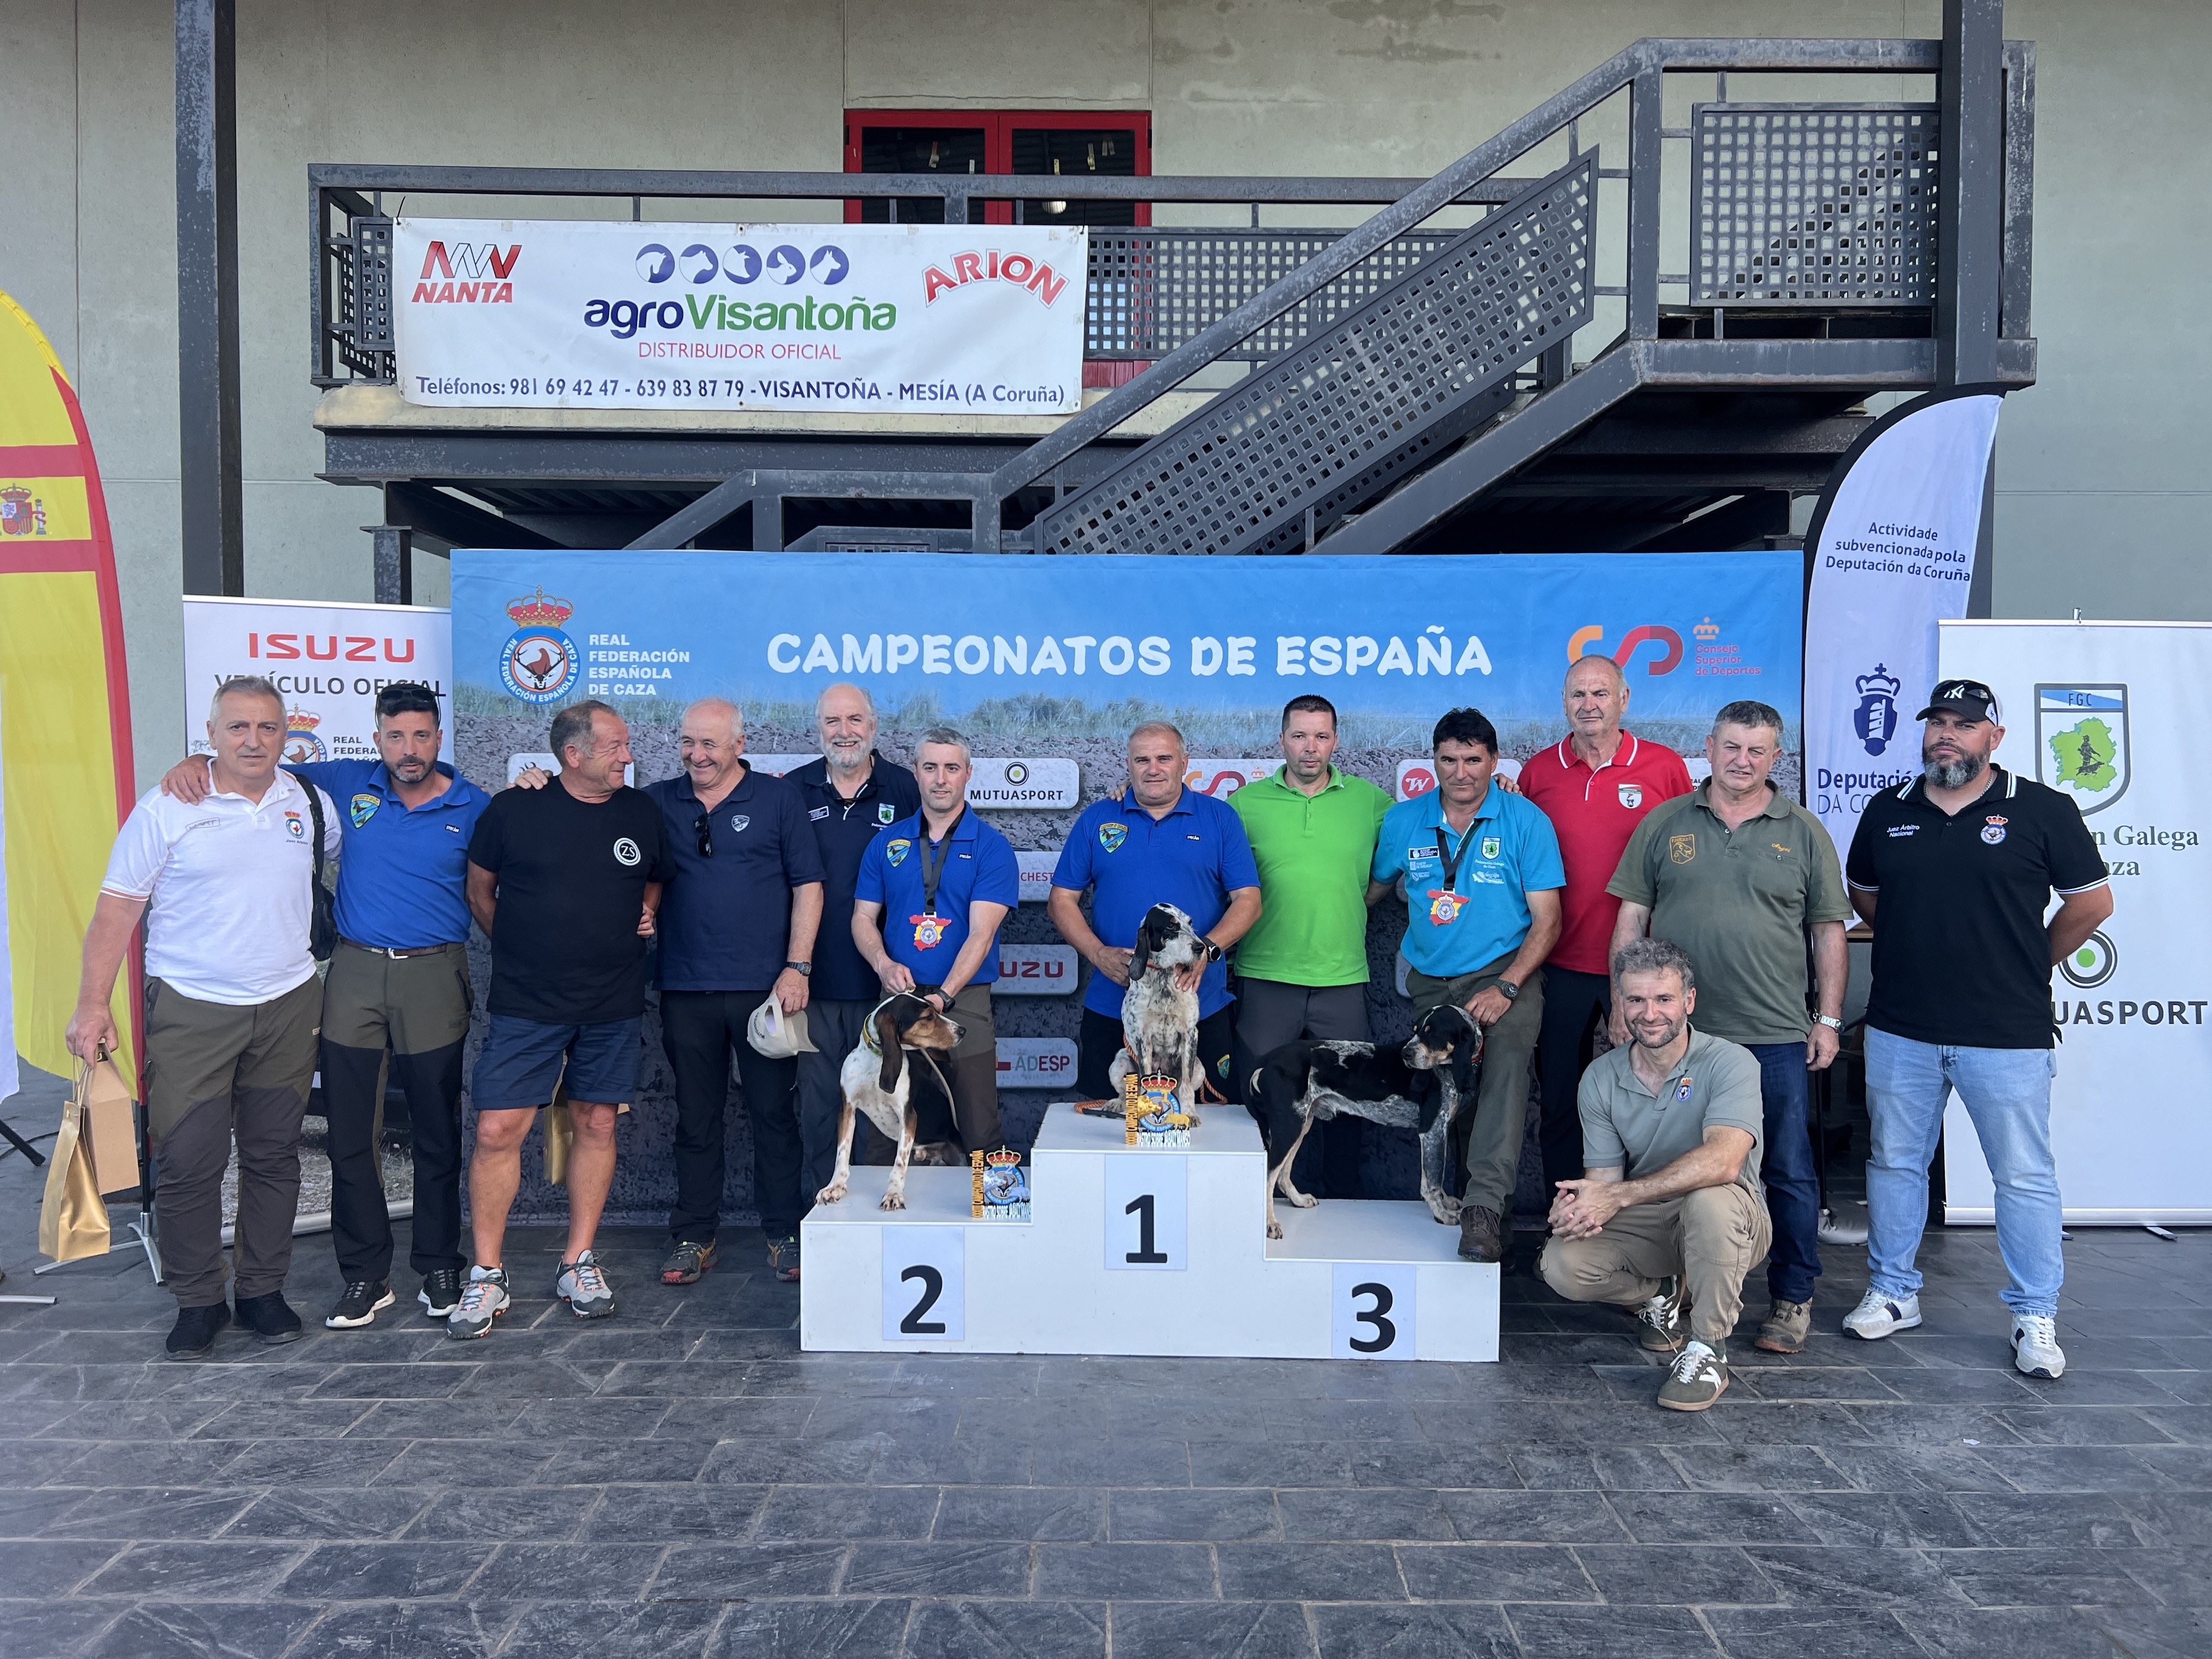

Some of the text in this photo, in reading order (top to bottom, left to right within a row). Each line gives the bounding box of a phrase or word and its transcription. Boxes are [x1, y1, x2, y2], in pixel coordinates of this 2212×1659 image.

[922, 249, 1070, 309] ARION
[411, 282, 513, 303] NANTA
[584, 294, 896, 338] agroVisantoña
[639, 342, 842, 359] DISTRIBUIDOR OFICIAL
[416, 376, 505, 394] Teléfonos:
[510, 378, 538, 395] 981
[545, 379, 566, 395] 69
[572, 379, 592, 396] 42
[599, 379, 619, 396] 47
[636, 379, 665, 397] 639
[673, 380, 692, 397] 83
[698, 380, 717, 397] 87
[725, 380, 743, 397] 79
[759, 377, 879, 399] VISANTOÑA
[900, 380, 959, 401] MESÍA
[965, 383, 986, 405] (A
[992, 385, 1064, 405] Coruña)
[1869, 522, 1938, 541] Actividade
[1835, 539, 1966, 563] subvencionada pola
[1826, 556, 1971, 581] Deputación da Coruña
[249, 633, 415, 663] ISUZU
[589, 634, 629, 645] REAL
[1695, 644, 1739, 654] Consejo
[589, 649, 690, 662] FEDERACIÓN
[768, 625, 1492, 676] CAMPEONATOS DE ESPAÑA
[1695, 654, 1742, 665] Superior
[502, 638, 578, 702] REAL FEDERACIÓN ESPAÑOLA DE CAZA
[589, 664, 672, 679] ESPAÑOLA
[1695, 666, 1761, 676] de Deportes
[214, 671, 345, 695] VÍCULO
[589, 684, 656, 695] DE CAZA
[2068, 693, 2092, 706] FGC
[314, 738, 325, 753] CAZA
[1818, 769, 1917, 794] Deputació
[970, 790, 1063, 801] MUTUASPORT
[1818, 794, 1842, 814] DA
[2114, 826, 2199, 851] Galega
[621, 845, 635, 857] ZS
[1015, 1056, 1070, 1071] ADESP
[1005, 1163, 1013, 1173] 2
[1126, 1194, 1167, 1263] 1
[900, 1265, 946, 1334] 2
[1350, 1282, 1396, 1352] 3
